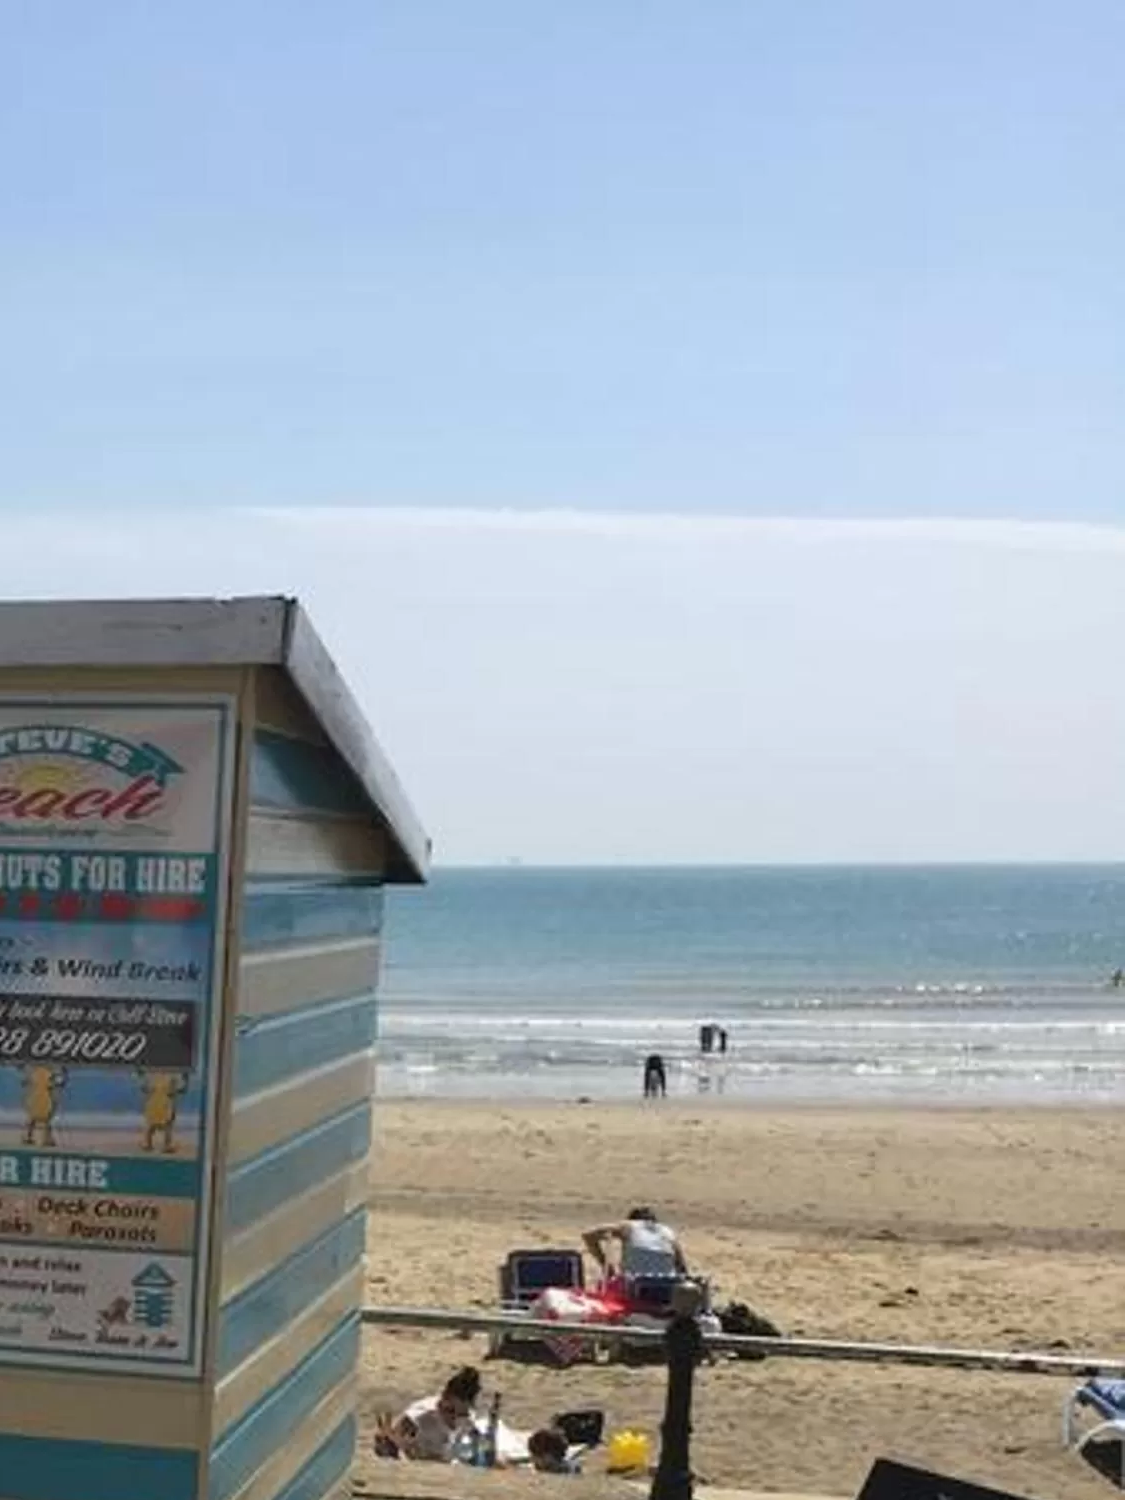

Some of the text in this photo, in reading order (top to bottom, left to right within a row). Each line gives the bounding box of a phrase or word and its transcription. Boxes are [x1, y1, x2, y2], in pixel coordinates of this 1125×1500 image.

[71, 856, 126, 891] FOR
[136, 857, 206, 892] HIRE
[30, 957, 49, 976] &
[58, 959, 121, 979] Wind
[128, 961, 202, 981] Break
[30, 1157, 109, 1187] HIRE
[38, 1196, 87, 1214] Deck
[94, 1201, 159, 1221] Chairs
[12, 1256, 40, 1271] and
